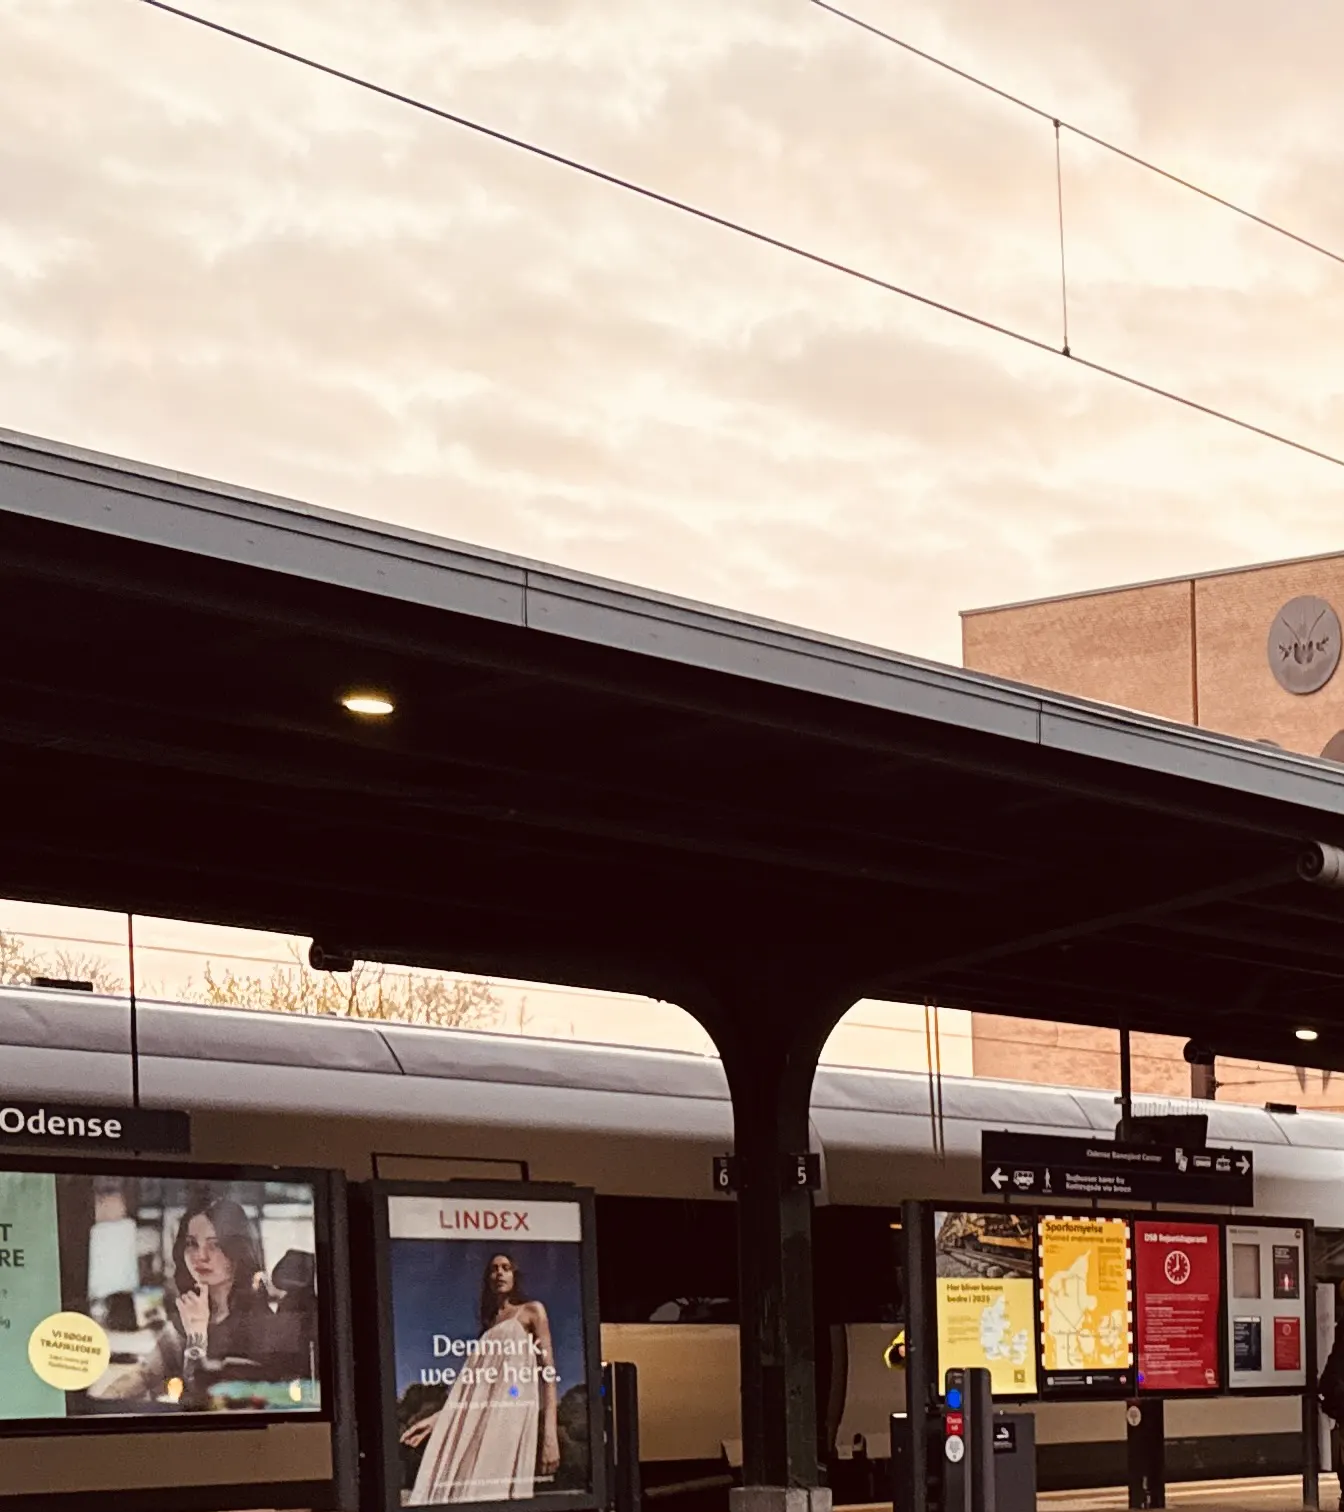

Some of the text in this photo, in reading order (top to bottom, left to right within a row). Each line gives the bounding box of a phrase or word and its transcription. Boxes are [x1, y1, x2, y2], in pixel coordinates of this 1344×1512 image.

[0, 1107, 122, 1138] Odense
[720, 1168, 728, 1186] 6
[797, 1166, 806, 1184] 5
[439, 1209, 530, 1232] LINDEX
[432, 1332, 548, 1359] Denmark,
[420, 1362, 562, 1386] we are here.
